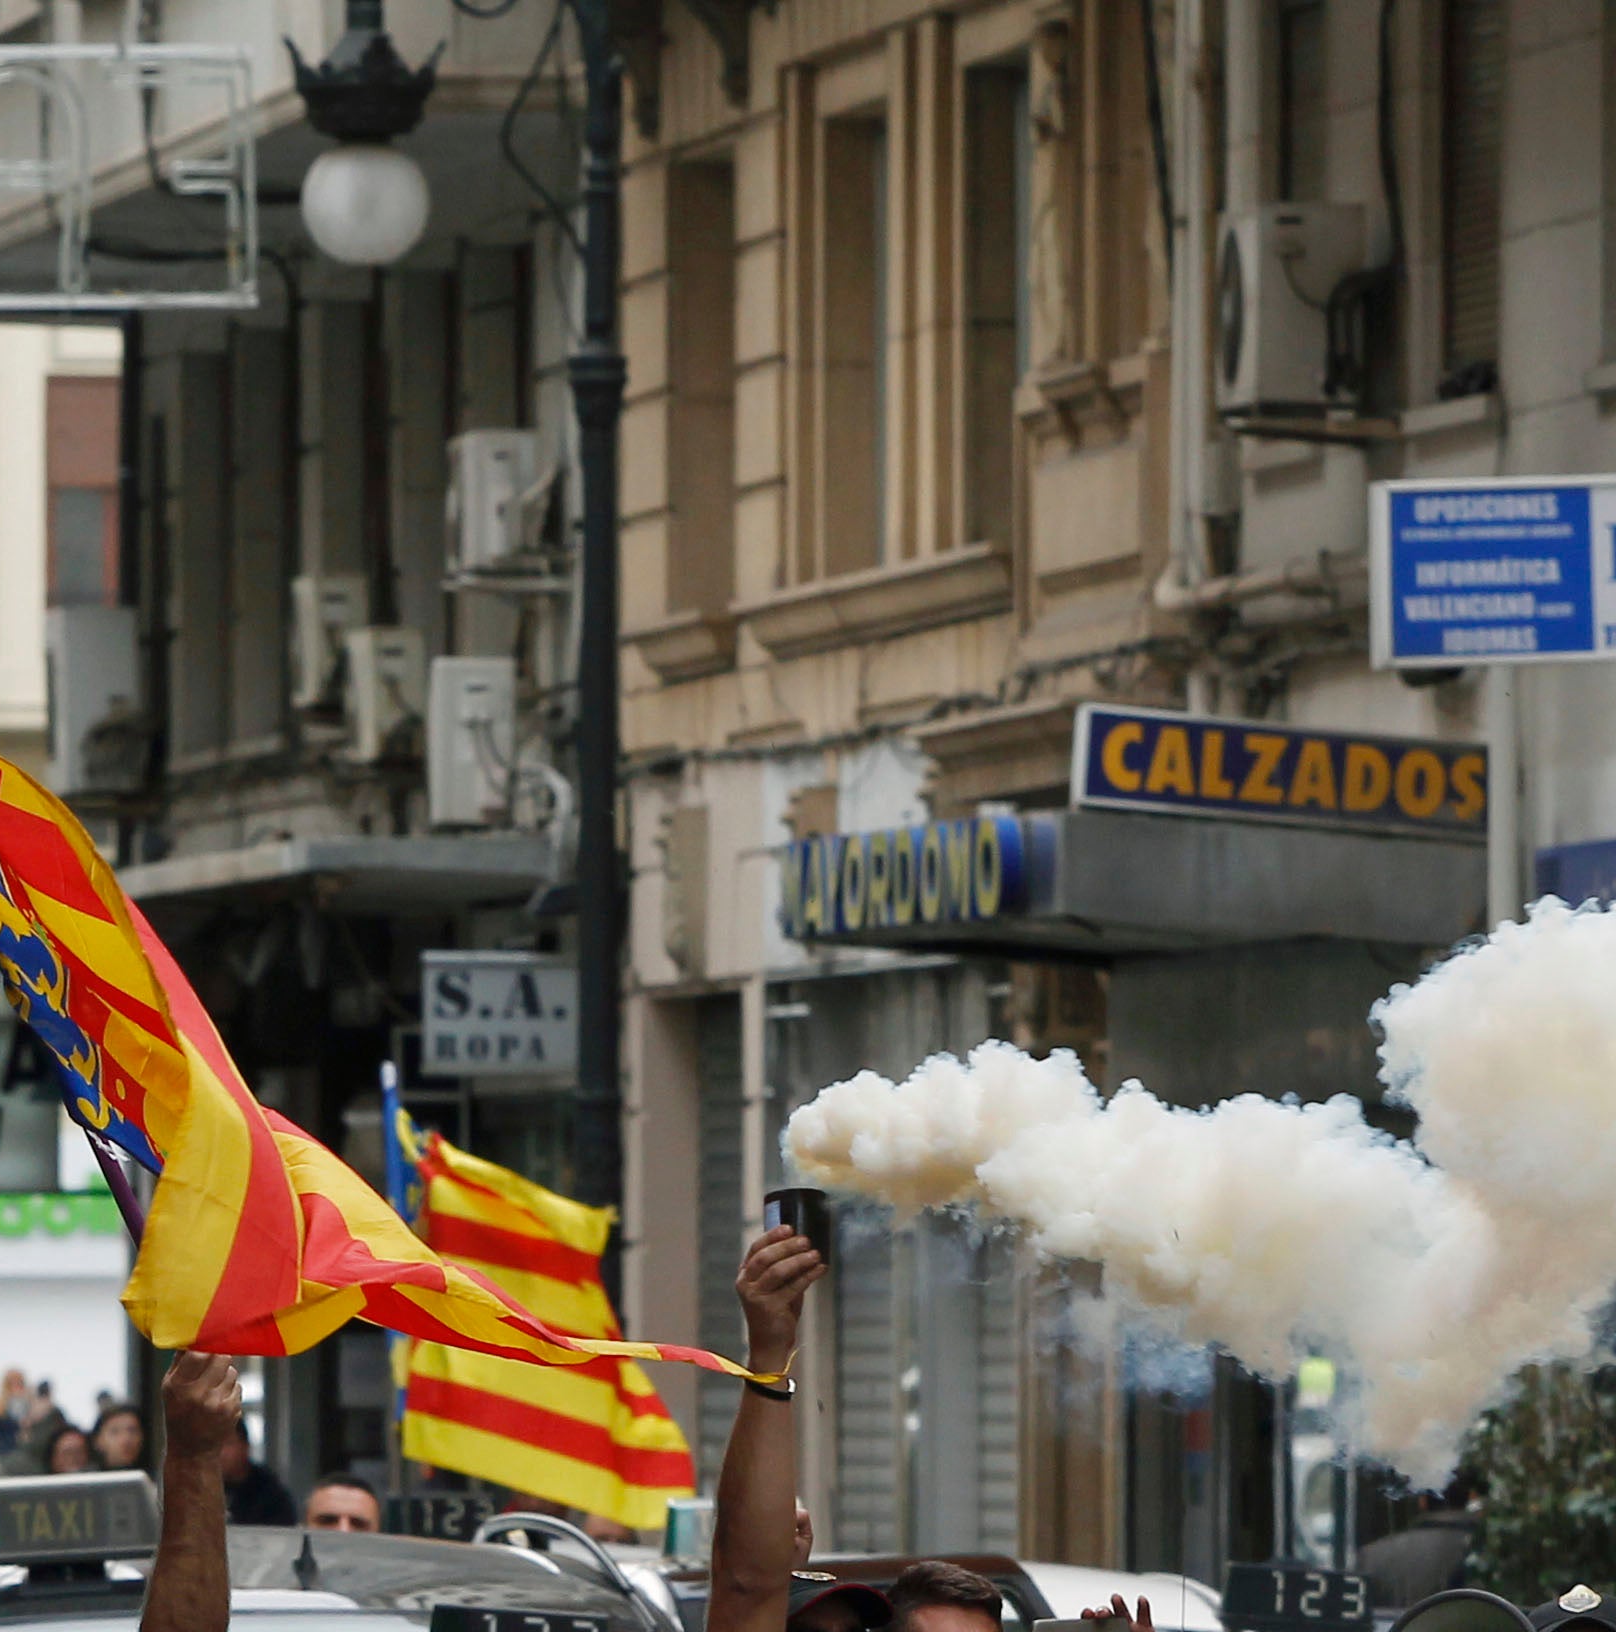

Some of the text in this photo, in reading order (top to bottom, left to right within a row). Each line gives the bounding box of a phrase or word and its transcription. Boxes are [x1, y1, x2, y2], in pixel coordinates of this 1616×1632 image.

[1414, 493, 1559, 523] OPOSICIONES
[1100, 721, 1487, 822] CALZADOS
[781, 816, 1003, 936] MAYORDOMO
[435, 971, 568, 1020] S.A.
[435, 1034, 547, 1062] ROPA
[10, 1500, 95, 1542] TAXI
[1271, 1569, 1368, 1619] 123
